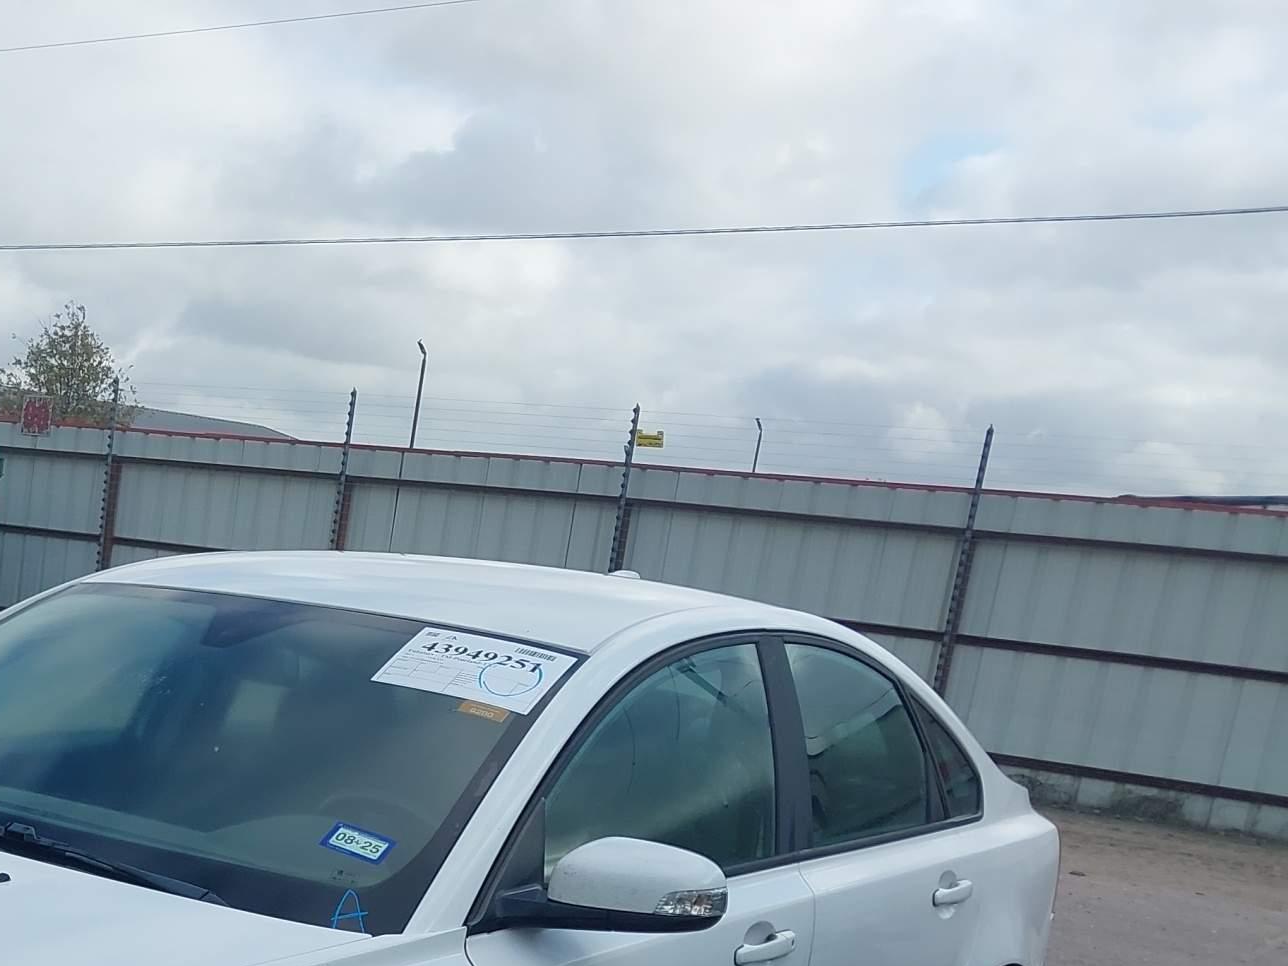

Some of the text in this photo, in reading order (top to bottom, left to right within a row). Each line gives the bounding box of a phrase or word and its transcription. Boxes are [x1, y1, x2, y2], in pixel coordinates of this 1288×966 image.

[421, 641, 544, 674] 43949251
[335, 832, 383, 854] 08 25
